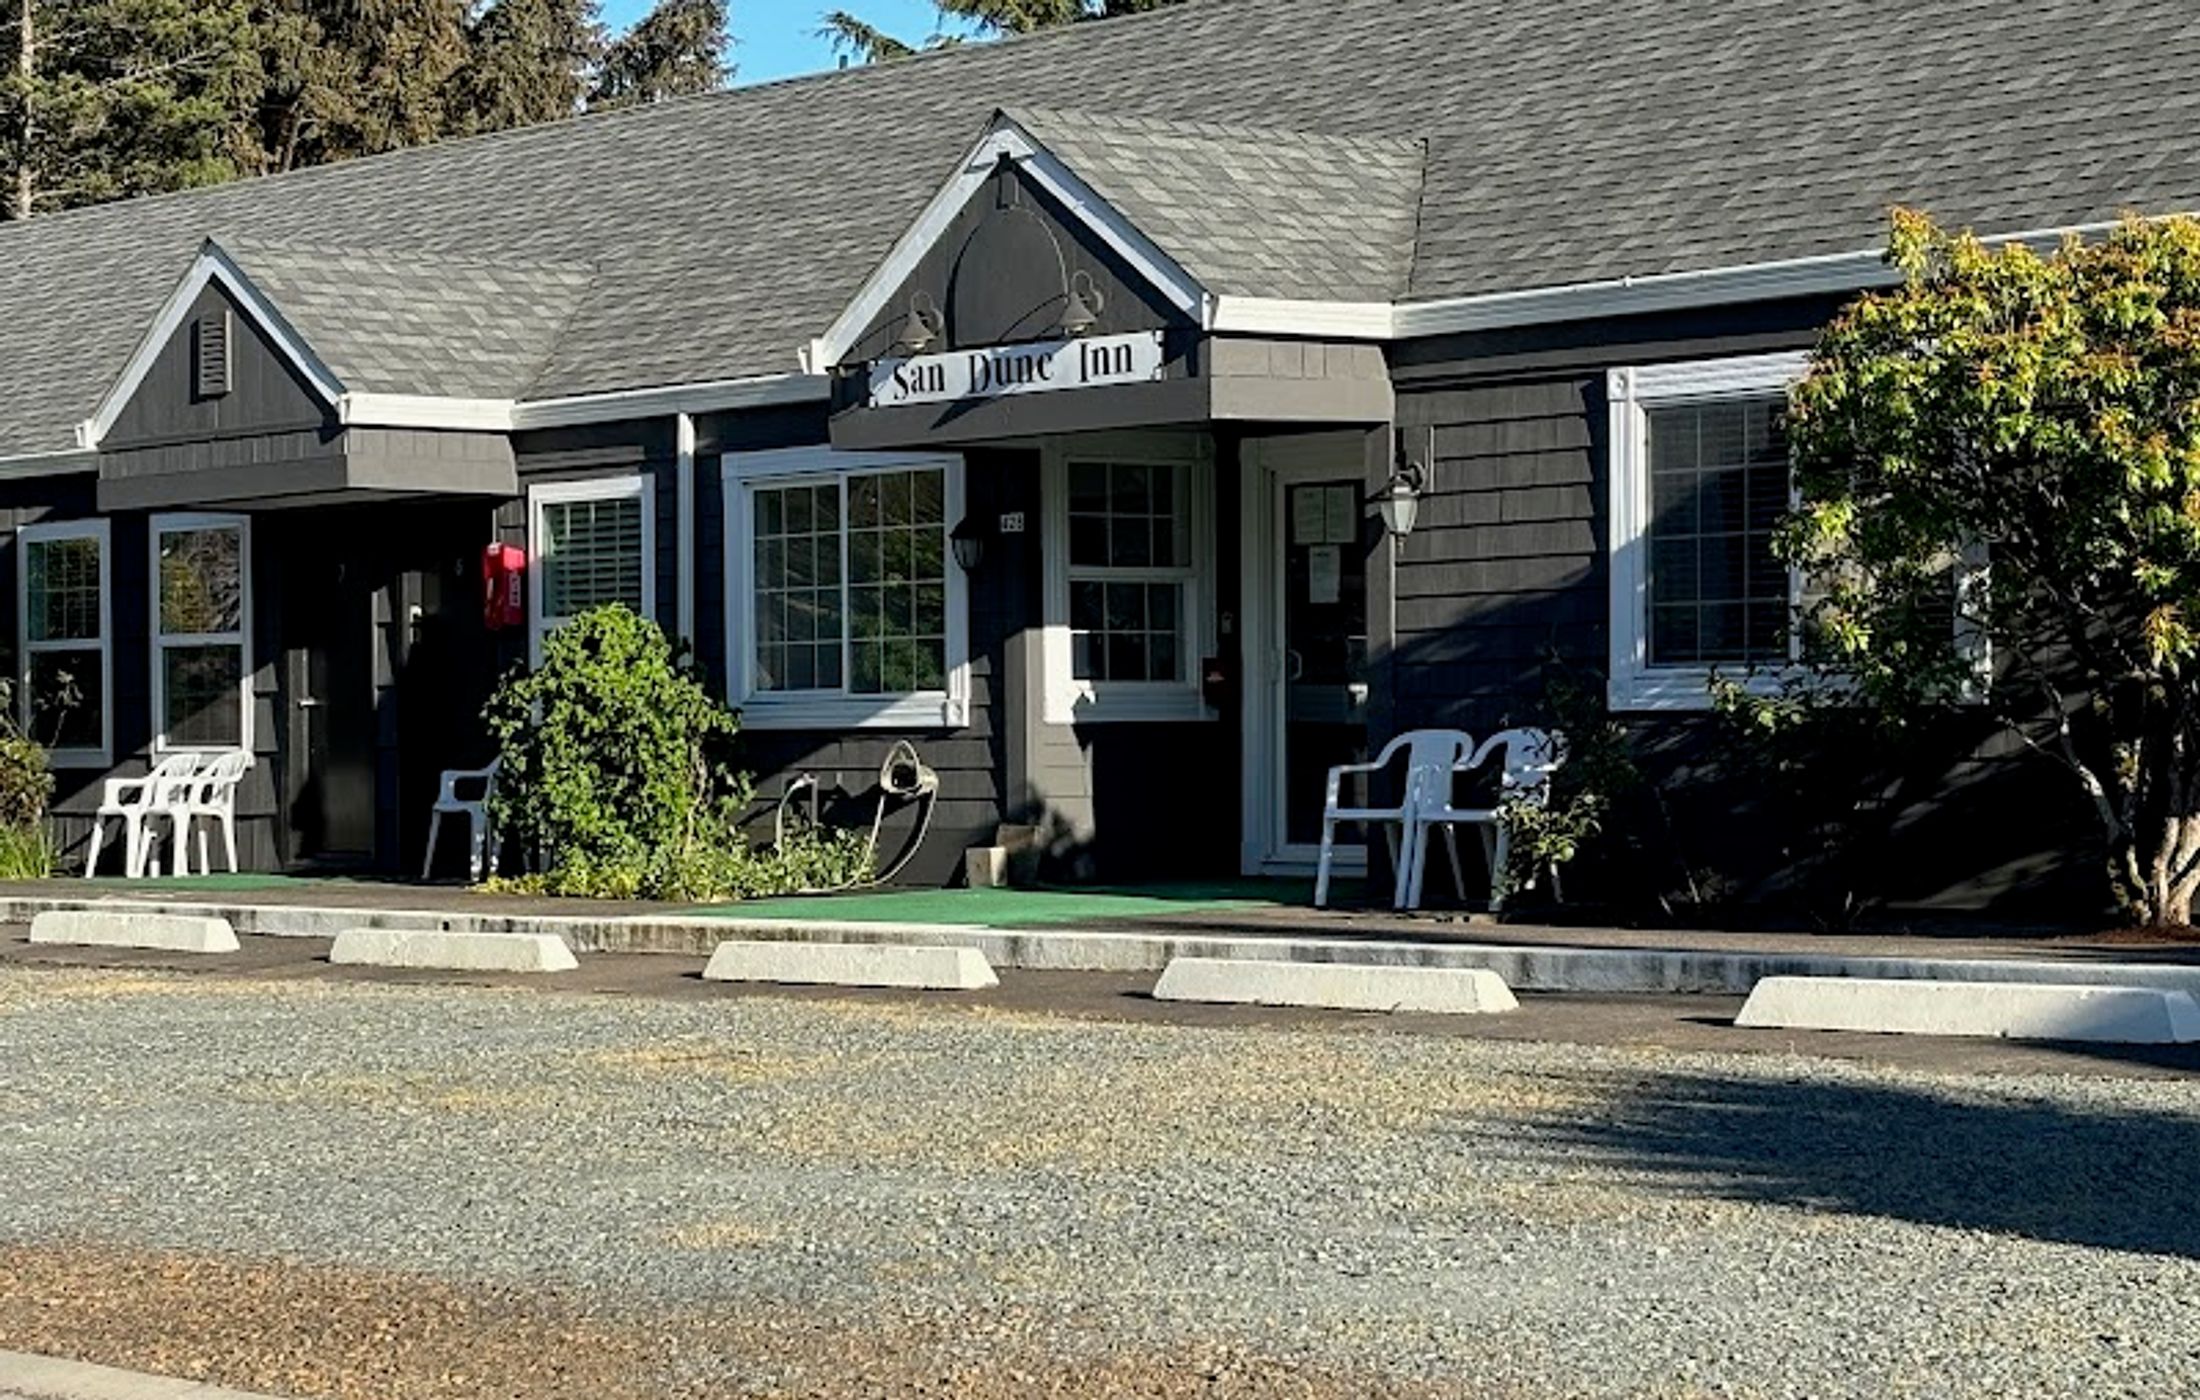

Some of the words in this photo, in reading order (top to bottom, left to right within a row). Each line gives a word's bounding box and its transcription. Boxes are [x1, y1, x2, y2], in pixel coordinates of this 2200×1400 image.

[893, 362, 945, 400] San
[968, 353, 1054, 393] Dune
[1079, 342, 1132, 383] Inn
